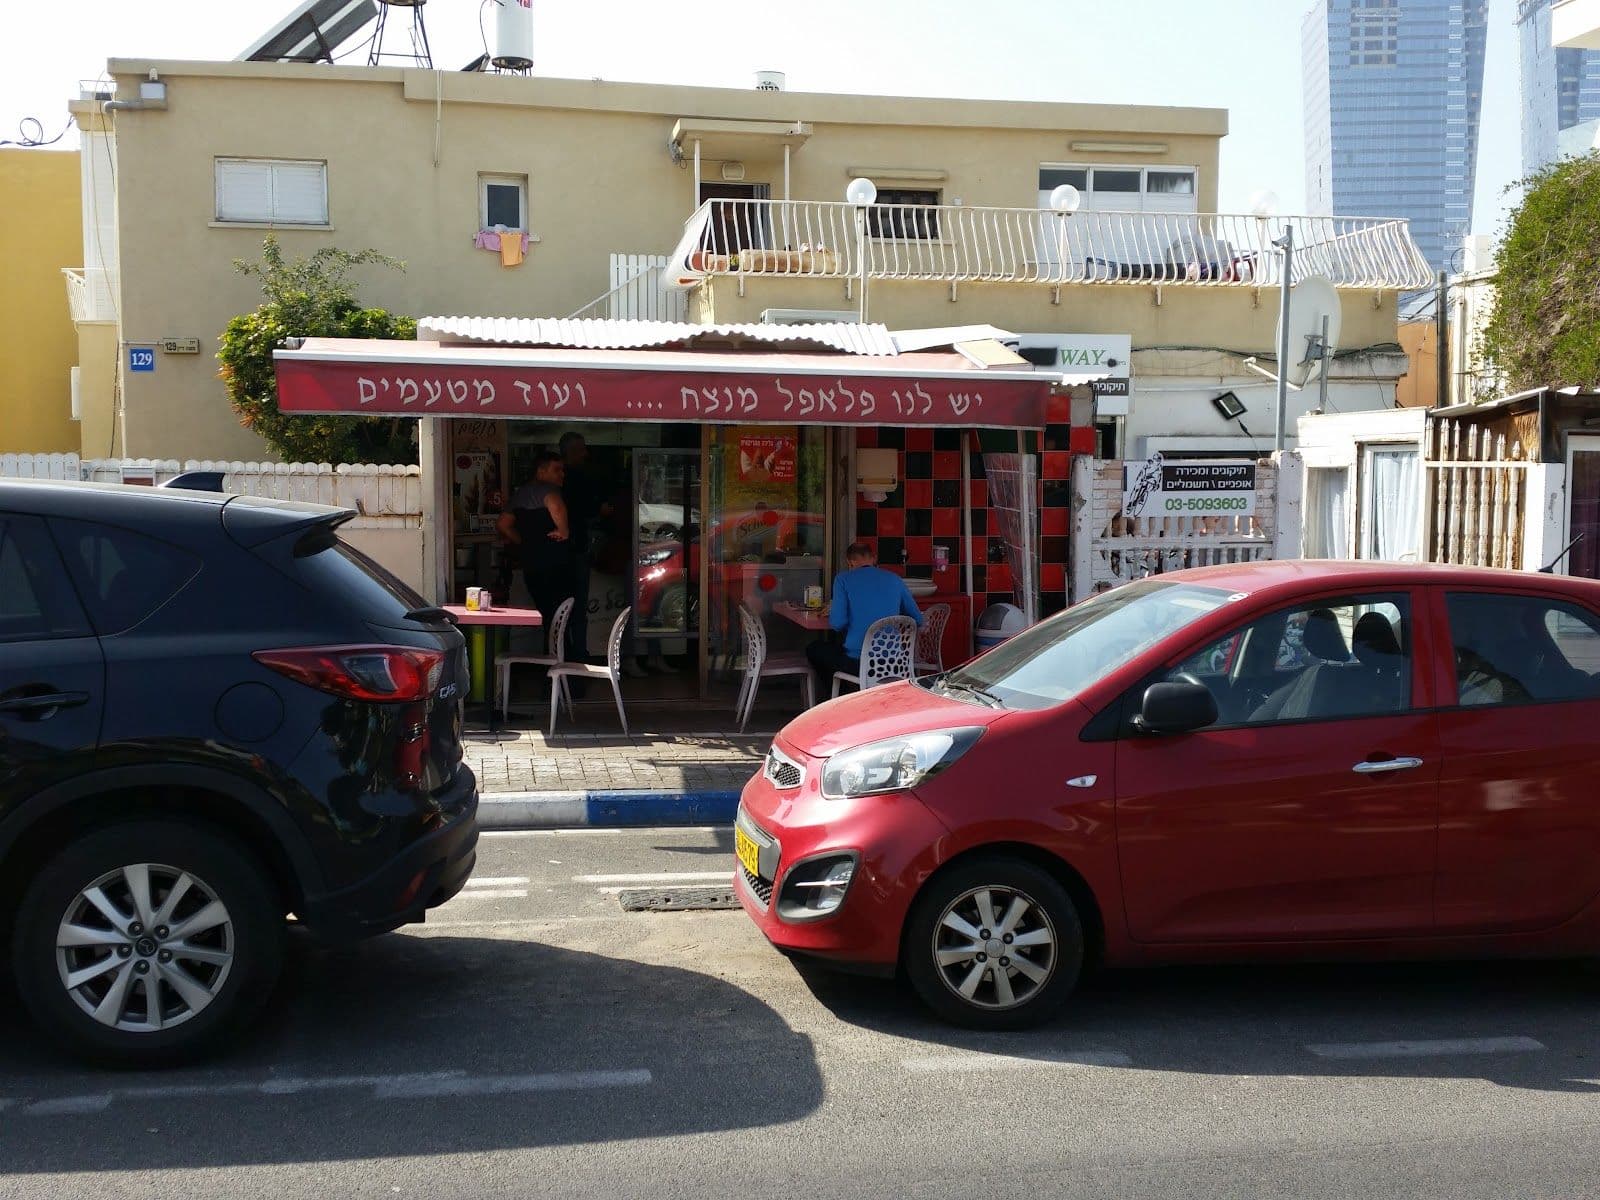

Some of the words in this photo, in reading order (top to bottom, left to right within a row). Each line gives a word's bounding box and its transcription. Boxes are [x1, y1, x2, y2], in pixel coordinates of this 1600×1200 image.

[165, 342, 177, 351] 129
[132, 353, 153, 366] 129
[1060, 349, 1105, 366] WAY
[357, 376, 497, 406] מטעמים
[513, 379, 587, 410] ועוד
[775, 377, 876, 416] פלאפל
[891, 382, 933, 415] לנו
[680, 385, 759, 413] מנצח
[948, 392, 983, 416] יש
[1175, 467, 1209, 475] ומכירה
[1210, 467, 1247, 477] תיקונים
[1166, 480, 1209, 489] חשמליים
[1217, 480, 1252, 489] אופנים
[1165, 497, 1248, 511] 03-5093603
